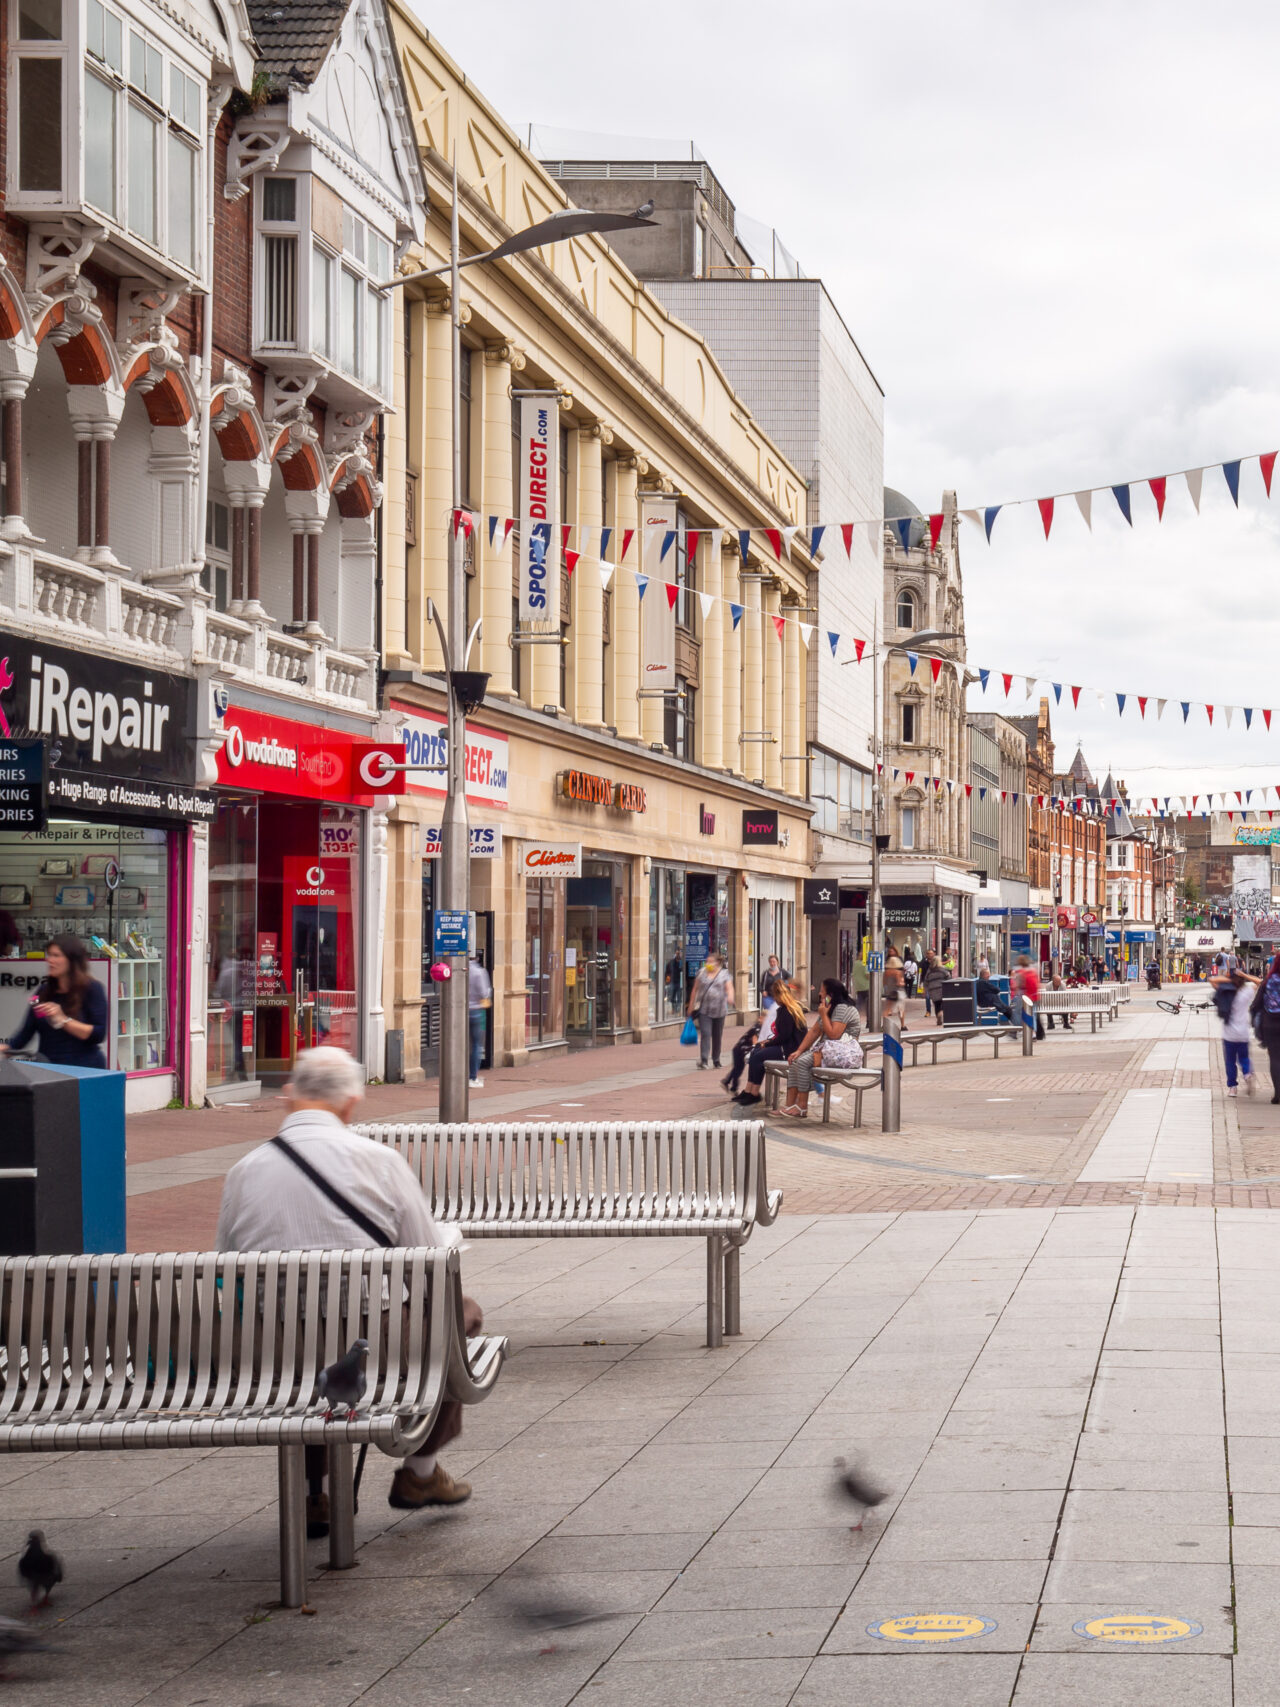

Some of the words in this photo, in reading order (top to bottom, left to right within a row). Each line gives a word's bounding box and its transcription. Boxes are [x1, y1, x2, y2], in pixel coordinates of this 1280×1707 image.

[530, 408, 547, 520] DIRECT.COM
[529, 522, 546, 610] SPOS
[29, 655, 169, 762] iRepair
[244, 736, 297, 769] vodafone
[301, 751, 332, 776] Southend
[400, 728, 447, 776] PORTS
[463, 743, 508, 789] RECT.COM
[61, 778, 82, 802] Huge
[83, 780, 107, 805] Range
[110, 785, 119, 802] of
[119, 786, 161, 809] Accessories
[167, 795, 178, 810] On
[179, 796, 195, 816] Spot
[195, 798, 215, 817] Repair
[568, 769, 613, 806] CLINTON
[620, 783, 647, 814] CARDS
[82, 828, 92, 839] &
[95, 828, 145, 841] iProtect
[426, 828, 494, 842] STS
[747, 821, 774, 834] hmv
[426, 843, 495, 853] DI.COM
[525, 850, 576, 867] Clinton
[296, 888, 335, 896] vodafone
[0, 973, 48, 991] Repa
[264, 980, 281, 988] back
